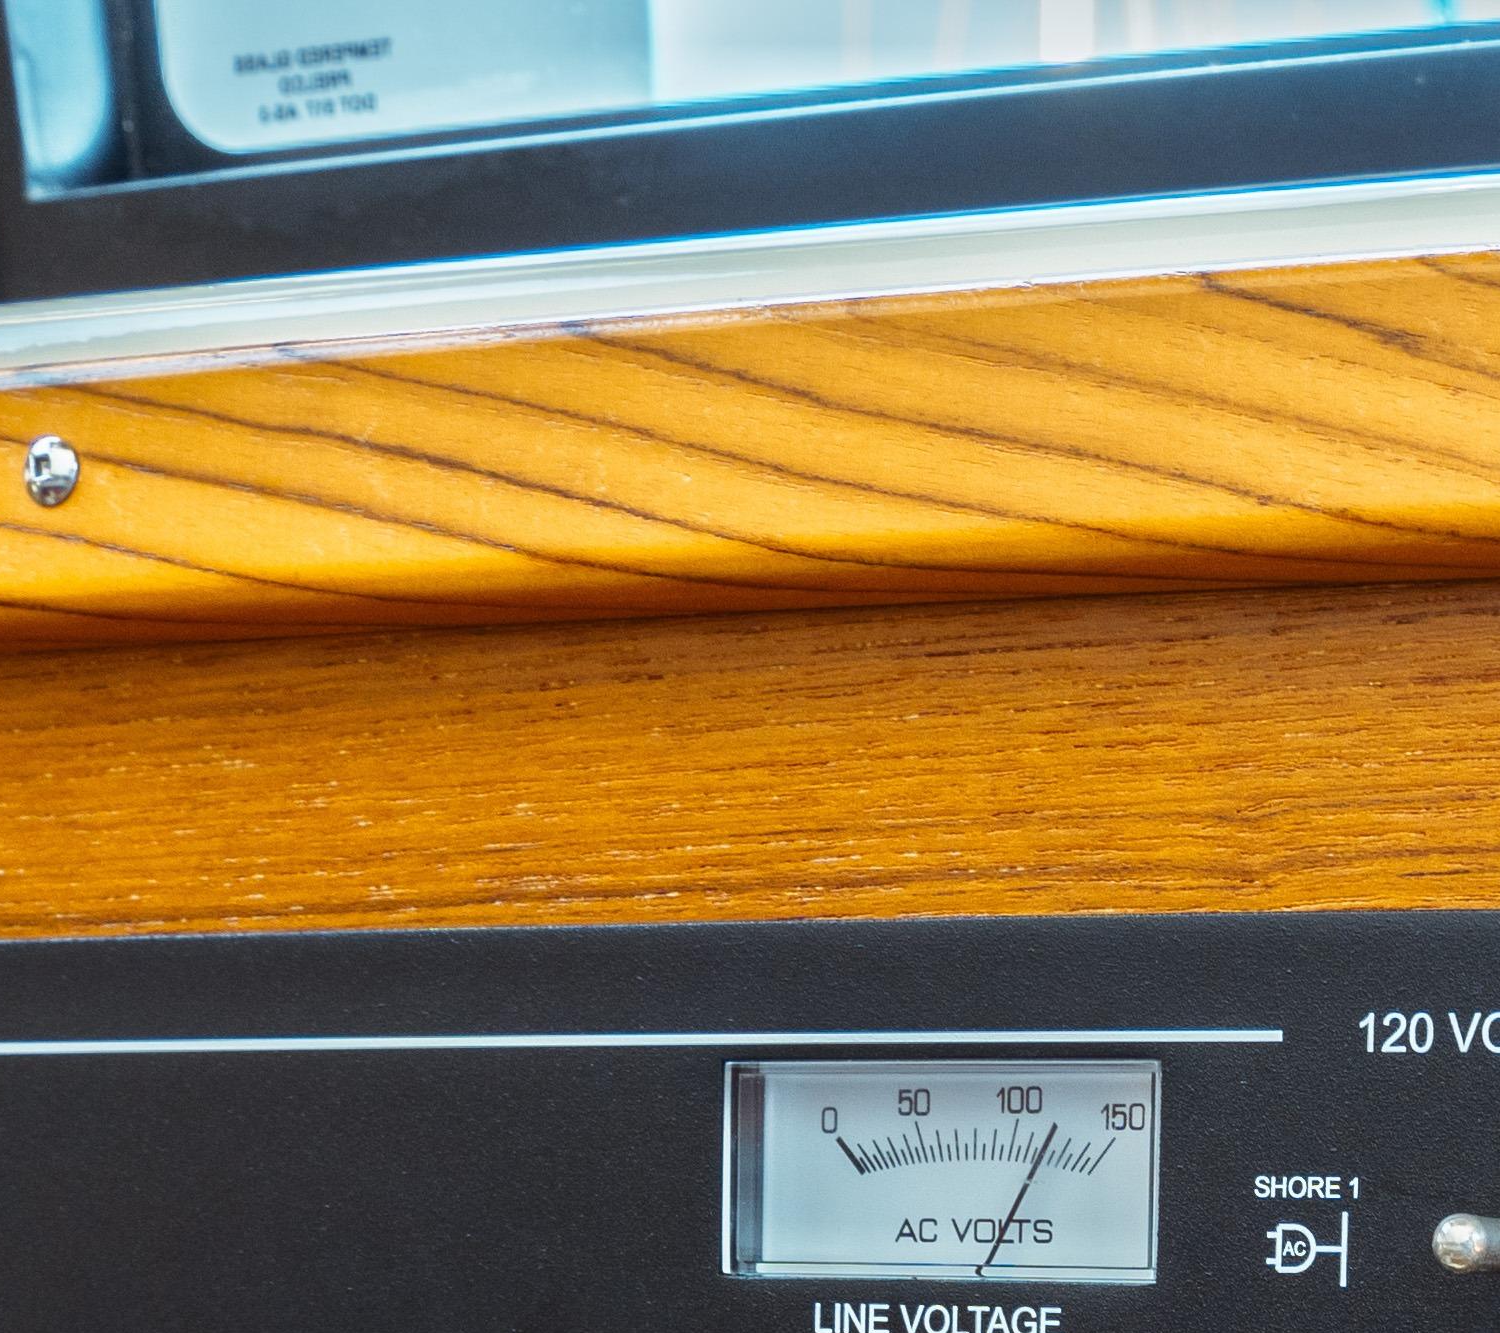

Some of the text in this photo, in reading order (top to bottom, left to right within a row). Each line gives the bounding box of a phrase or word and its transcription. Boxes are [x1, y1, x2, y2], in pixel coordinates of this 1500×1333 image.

[1358, 1012, 1434, 1054] 120
[897, 1087, 931, 1117] 50
[996, 1085, 1043, 1115] 100
[821, 1106, 839, 1135] 0
[1100, 1102, 1146, 1131] 150
[1253, 1175, 1359, 1199] SHORE 1
[896, 1218, 1053, 1243] AC VOLTS
[1282, 1239, 1306, 1256] AC
